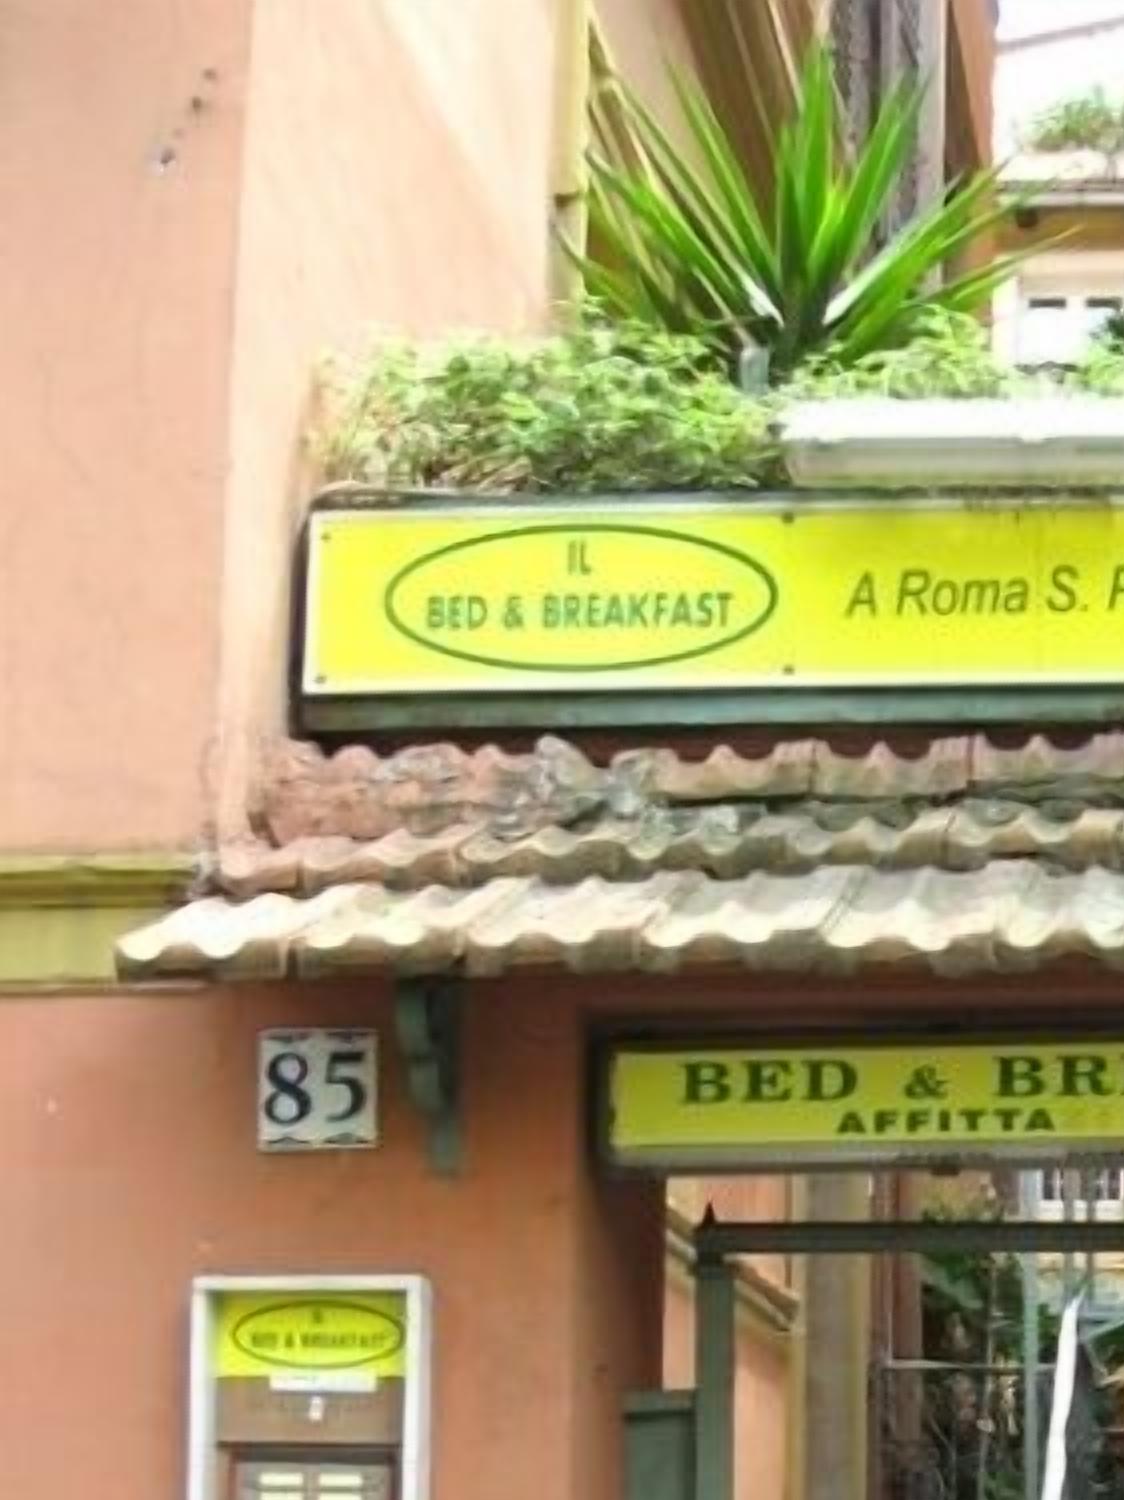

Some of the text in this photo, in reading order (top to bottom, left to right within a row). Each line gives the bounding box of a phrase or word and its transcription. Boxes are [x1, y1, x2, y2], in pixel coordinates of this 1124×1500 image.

[567, 540, 593, 576] IL
[425, 591, 735, 630] BED & BREAKFAST
[844, 569, 878, 617] A
[896, 568, 1030, 616] Roma
[1046, 564, 1089, 612] S.
[264, 1051, 367, 1127] 85
[679, 1058, 858, 1104] BED
[903, 1063, 949, 1100] &
[835, 1107, 1057, 1135] AFFITTA
